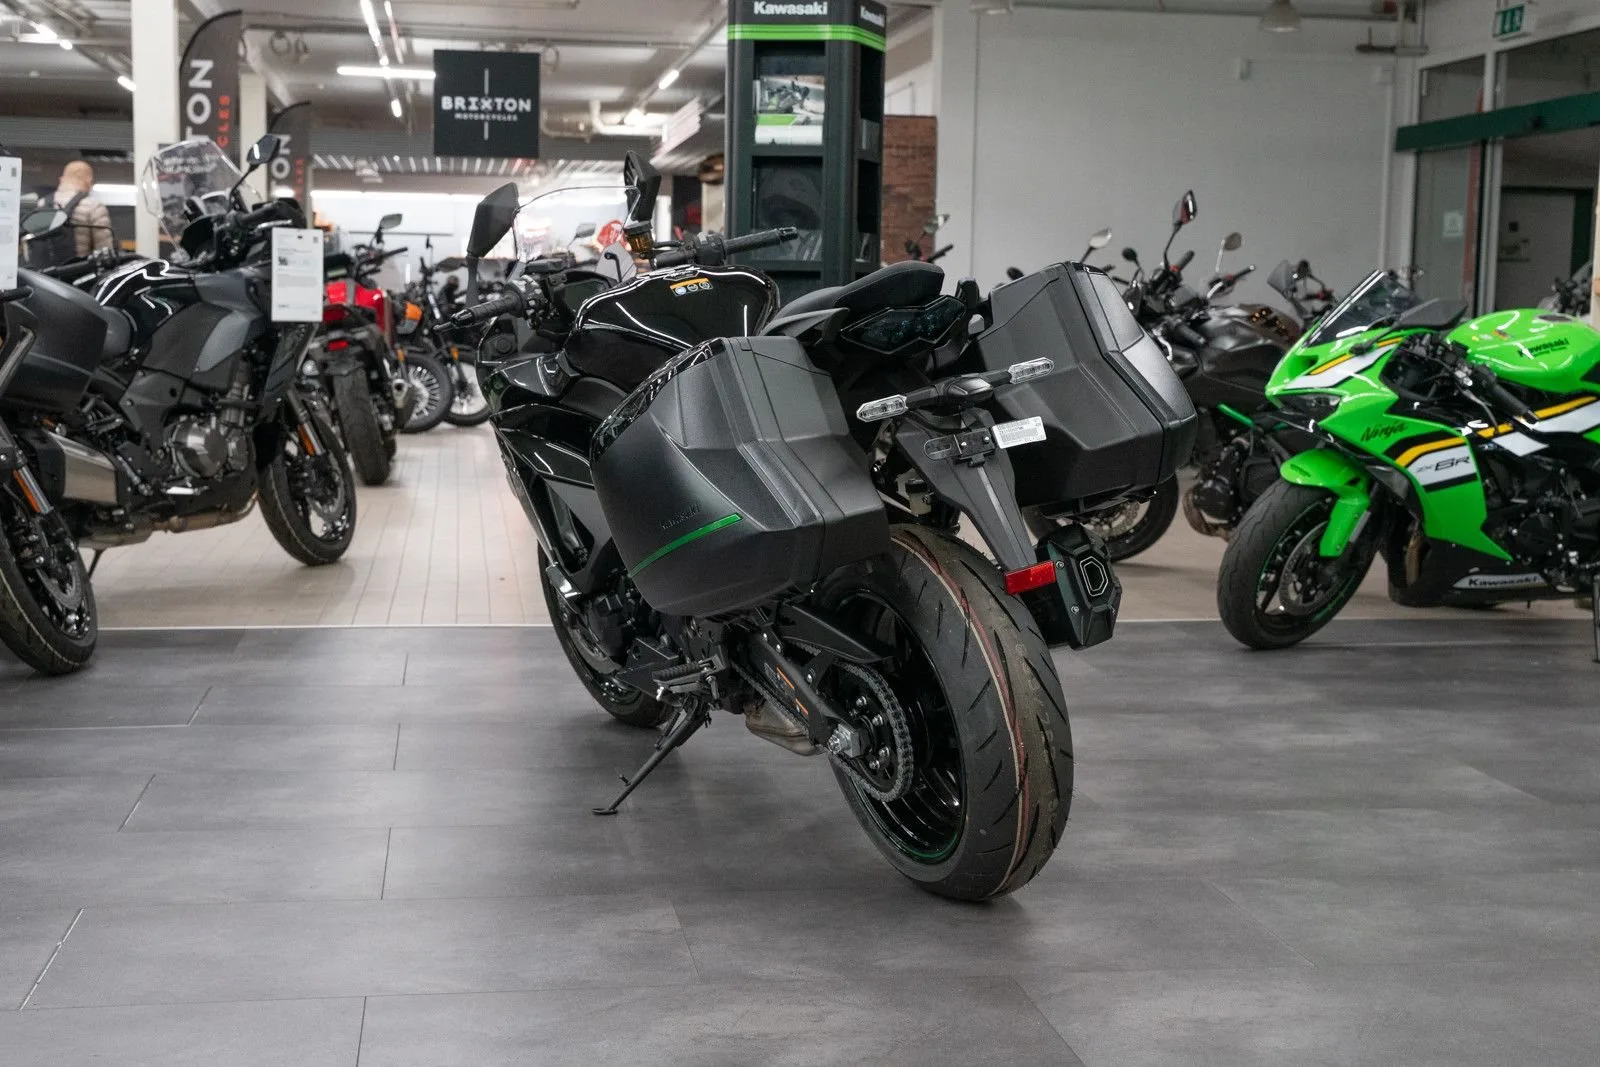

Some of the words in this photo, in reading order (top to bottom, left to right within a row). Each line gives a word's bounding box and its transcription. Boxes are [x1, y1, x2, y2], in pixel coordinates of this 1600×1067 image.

[753, 1, 828, 15] Kawasaki
[441, 95, 533, 112] BRIXTON
[454, 113, 518, 121] MOTORCYCLES
[1360, 421, 1408, 441] Ninja
[1468, 576, 1538, 586] Kawasaki
